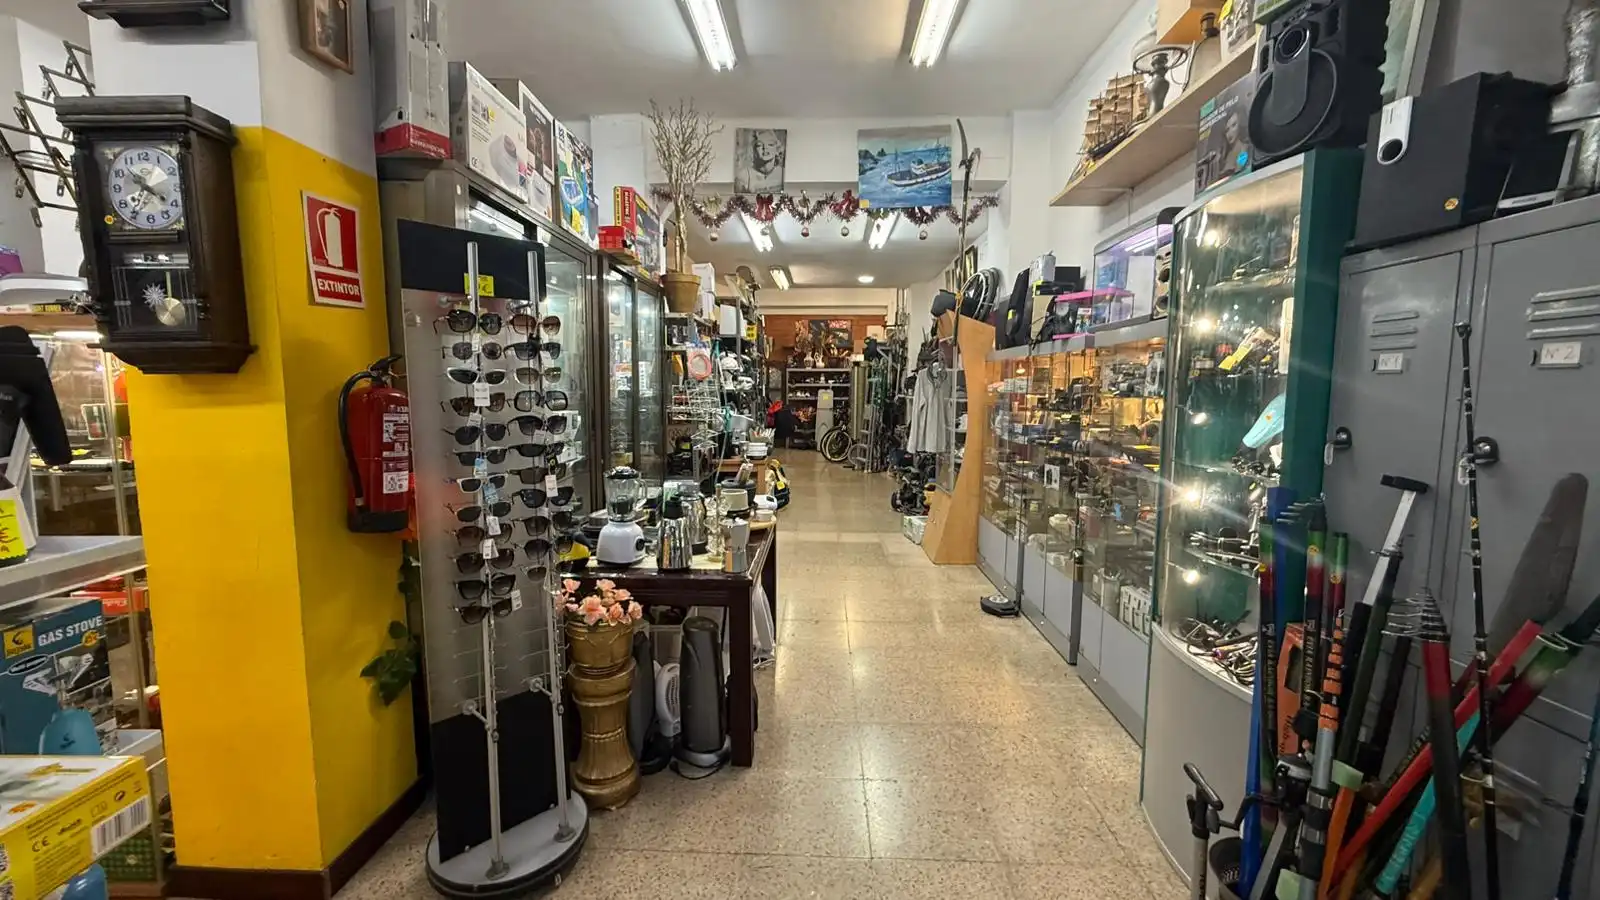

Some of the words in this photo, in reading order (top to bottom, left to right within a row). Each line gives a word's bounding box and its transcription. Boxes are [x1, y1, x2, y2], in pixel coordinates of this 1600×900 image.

[124, 156, 133, 165] 11
[137, 151, 149, 161] 12
[114, 169, 125, 178] 10
[167, 167, 177, 176] 2
[113, 184, 122, 193] 9
[119, 200, 128, 208] 8
[170, 199, 178, 208] 4
[146, 214, 156, 224] 6
[161, 210, 170, 220] 5
[317, 278, 360, 296] EXTINTOR
[1563, 345, 1575, 360] 2
[38, 629, 64, 647] GAS
[65, 615, 103, 637] STOVE
[31, 835, 50, 853] CE
